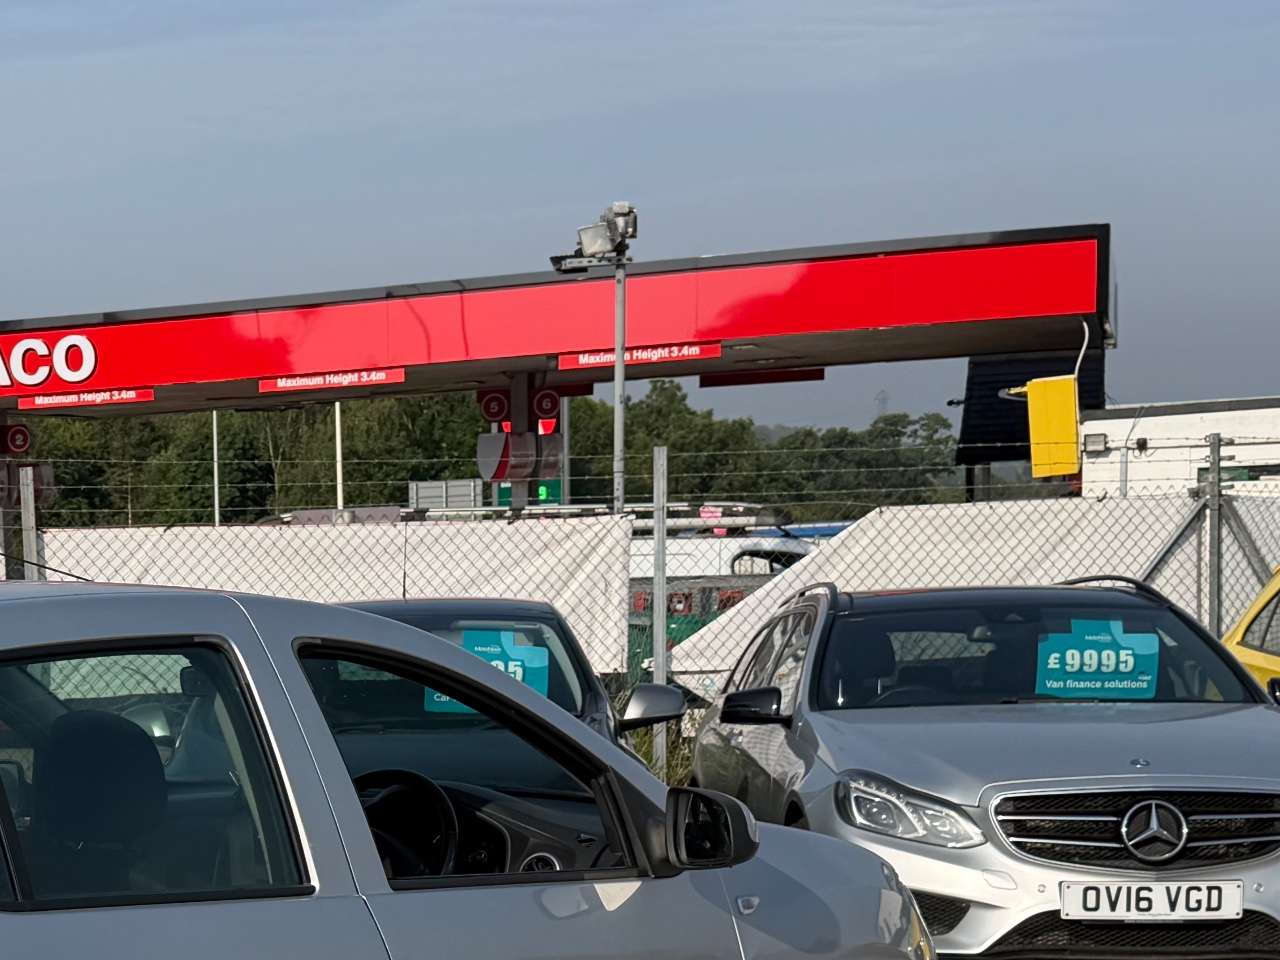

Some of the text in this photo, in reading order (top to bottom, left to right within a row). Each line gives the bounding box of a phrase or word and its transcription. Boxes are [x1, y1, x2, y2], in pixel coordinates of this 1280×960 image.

[633, 348, 669, 362] Height
[671, 345, 700, 356] 3.4m
[277, 371, 386, 388] Maximum Height 3.4m
[34, 389, 136, 405] Maximum Height 3.4m
[542, 398, 552, 409] 6
[489, 402, 499, 413] 5
[15, 434, 25, 446] 2
[1045, 680, 1148, 689] Van finance solutions
[1082, 886, 1223, 912] OV16 VGD
